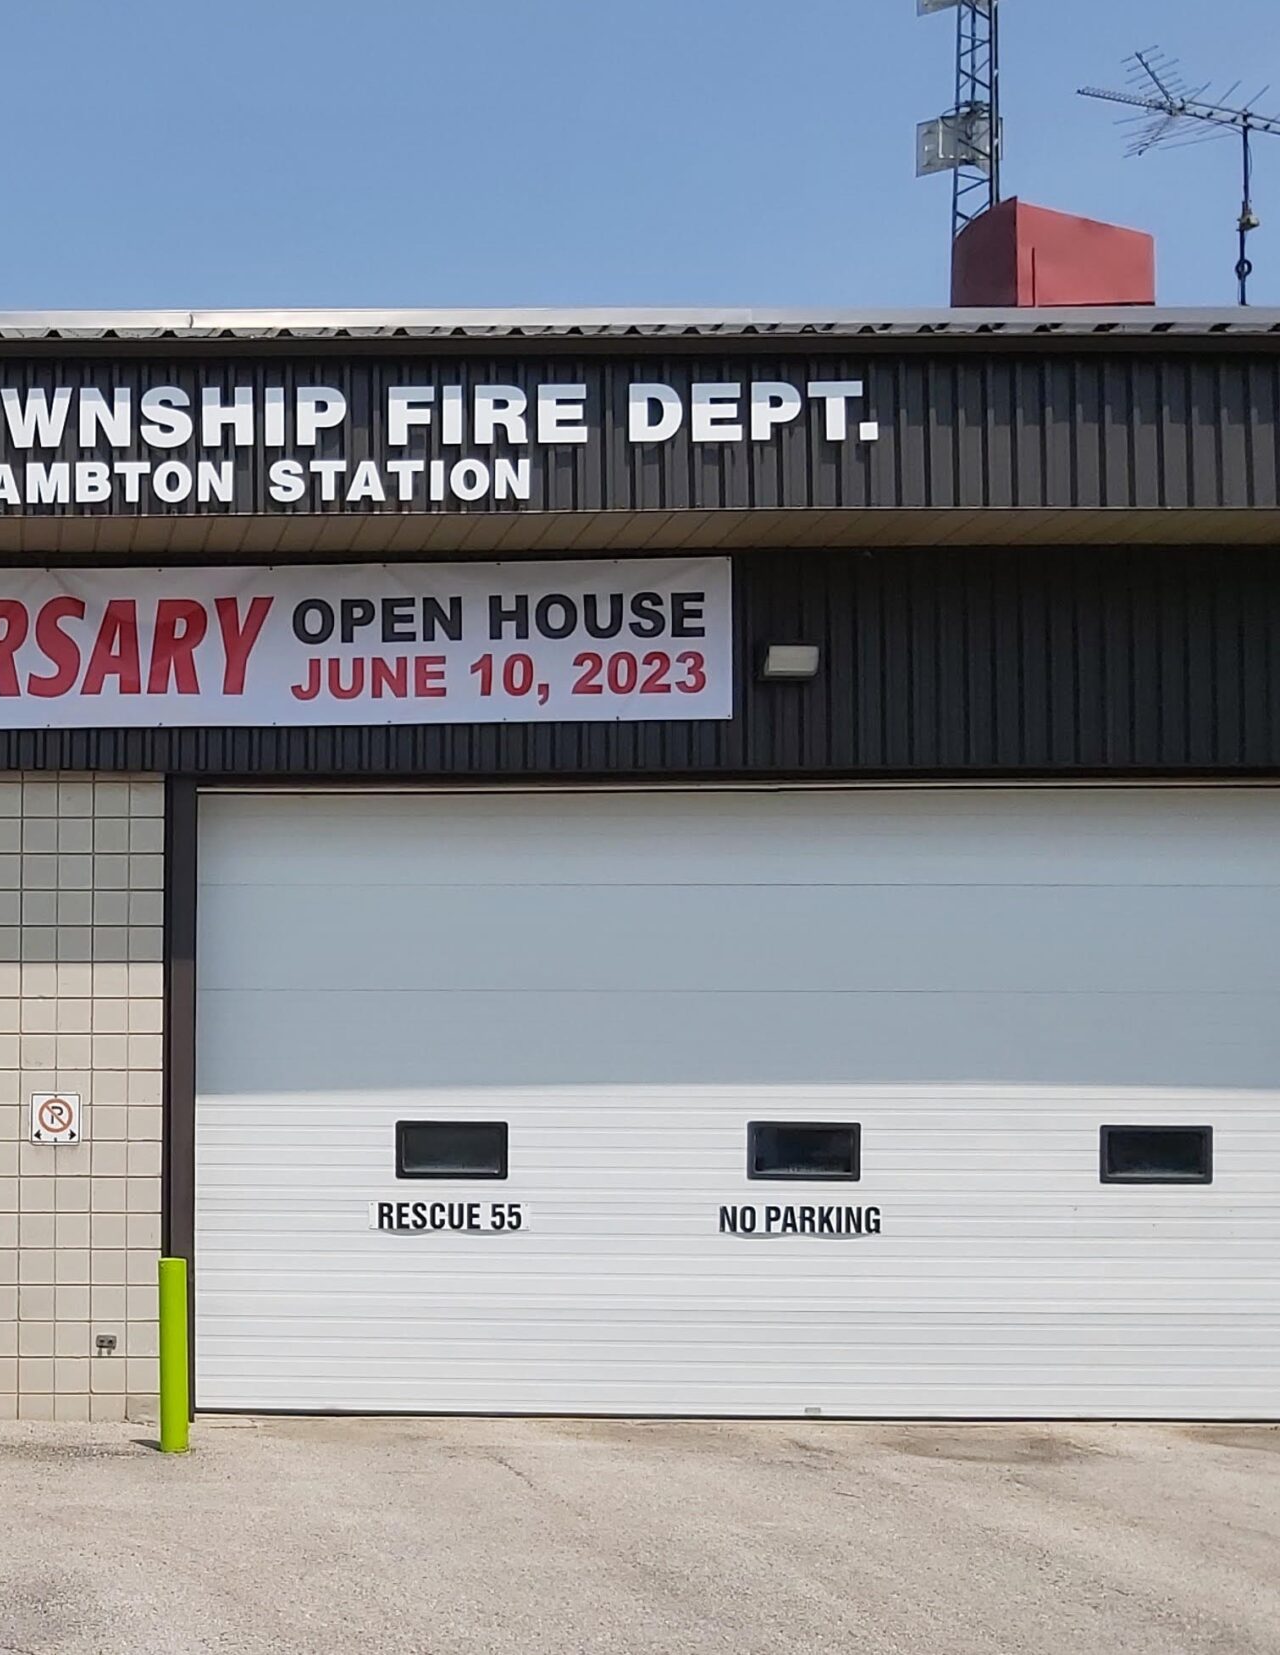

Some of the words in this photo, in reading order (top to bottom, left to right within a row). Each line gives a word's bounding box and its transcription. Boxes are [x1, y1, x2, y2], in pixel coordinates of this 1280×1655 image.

[387, 383, 588, 446] FIRE
[628, 380, 879, 443] DEPT.
[269, 458, 530, 502] STATION
[291, 596, 462, 645] OPEN
[488, 591, 707, 641] HOUSE
[290, 654, 447, 701] JUNE
[470, 651, 550, 705] 10,
[571, 650, 708, 697] 2023
[377, 1201, 481, 1231] RESCUE
[489, 1202, 522, 1231] 55
[720, 1205, 757, 1234] NO
[764, 1205, 882, 1235] PARKING
